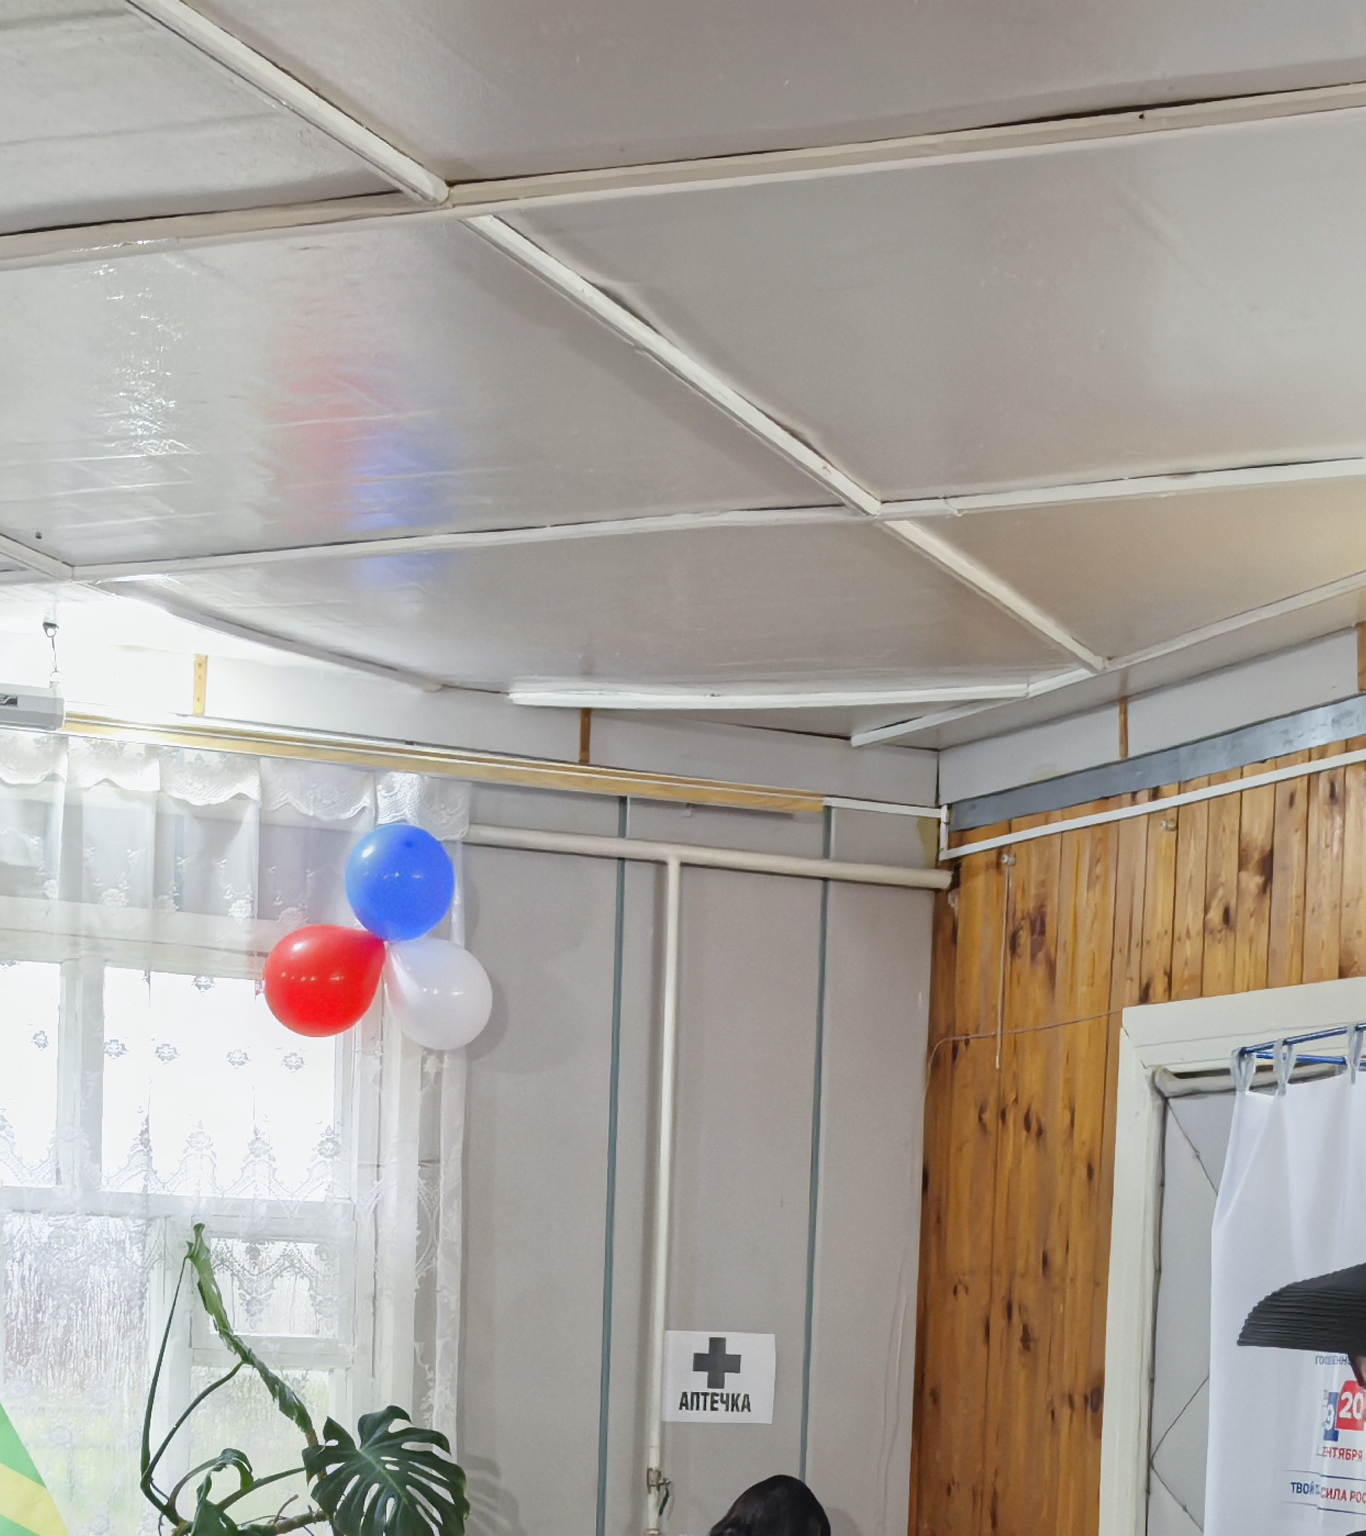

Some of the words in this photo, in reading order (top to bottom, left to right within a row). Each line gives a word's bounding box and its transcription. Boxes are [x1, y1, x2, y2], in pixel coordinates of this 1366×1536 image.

[678, 1391, 752, 1413] АПТЕЧКА
[1339, 1391, 1364, 1420] 20
[1321, 1486, 1347, 1501] СИЛА
